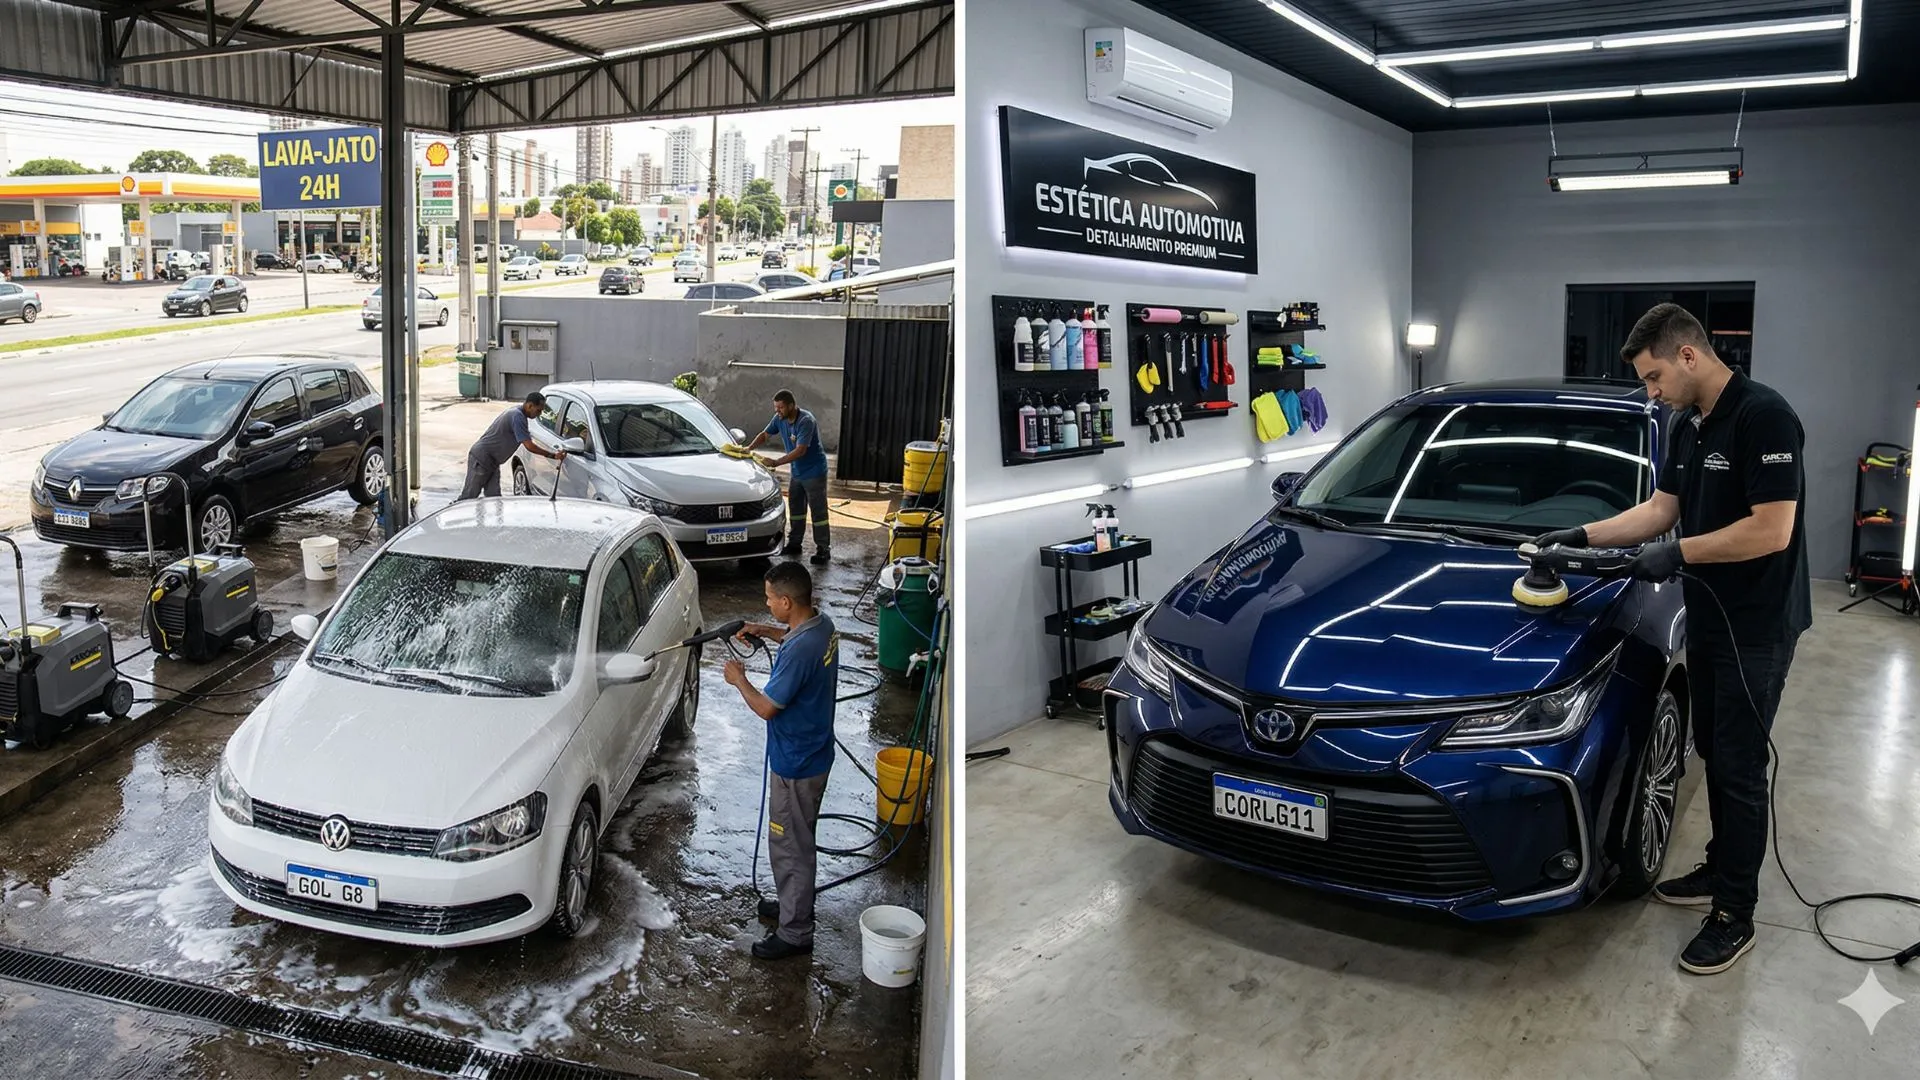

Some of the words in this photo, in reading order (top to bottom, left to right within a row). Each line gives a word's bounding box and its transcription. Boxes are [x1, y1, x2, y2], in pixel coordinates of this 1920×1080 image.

[263, 135, 376, 167] LAVA-JATO
[299, 173, 341, 201] 24H
[1035, 182, 1135, 226] ESTÉTICA
[1139, 203, 1245, 244] AUTOMOTIVA
[1086, 227, 1173, 254] DETALHAMENTO
[1174, 241, 1217, 260] PREMIUM
[1225, 792, 1315, 832] CORLG11
[299, 876, 331, 898] GOL
[343, 885, 363, 904] G8
